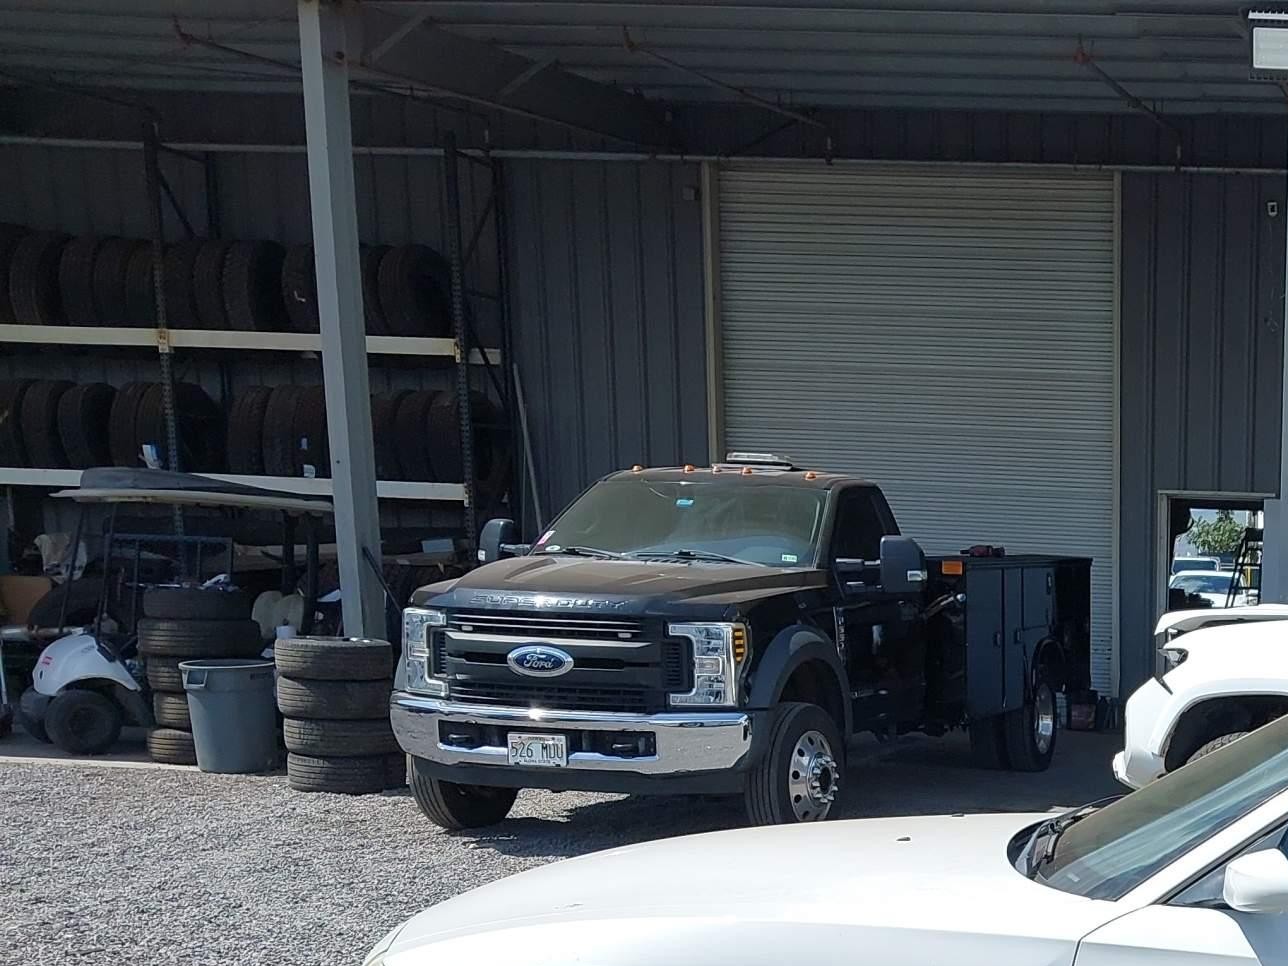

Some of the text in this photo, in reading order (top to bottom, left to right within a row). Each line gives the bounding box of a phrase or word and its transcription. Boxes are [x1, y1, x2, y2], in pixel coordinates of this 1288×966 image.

[523, 654, 554, 668] Ford
[511, 741, 565, 760] 526 MDU
